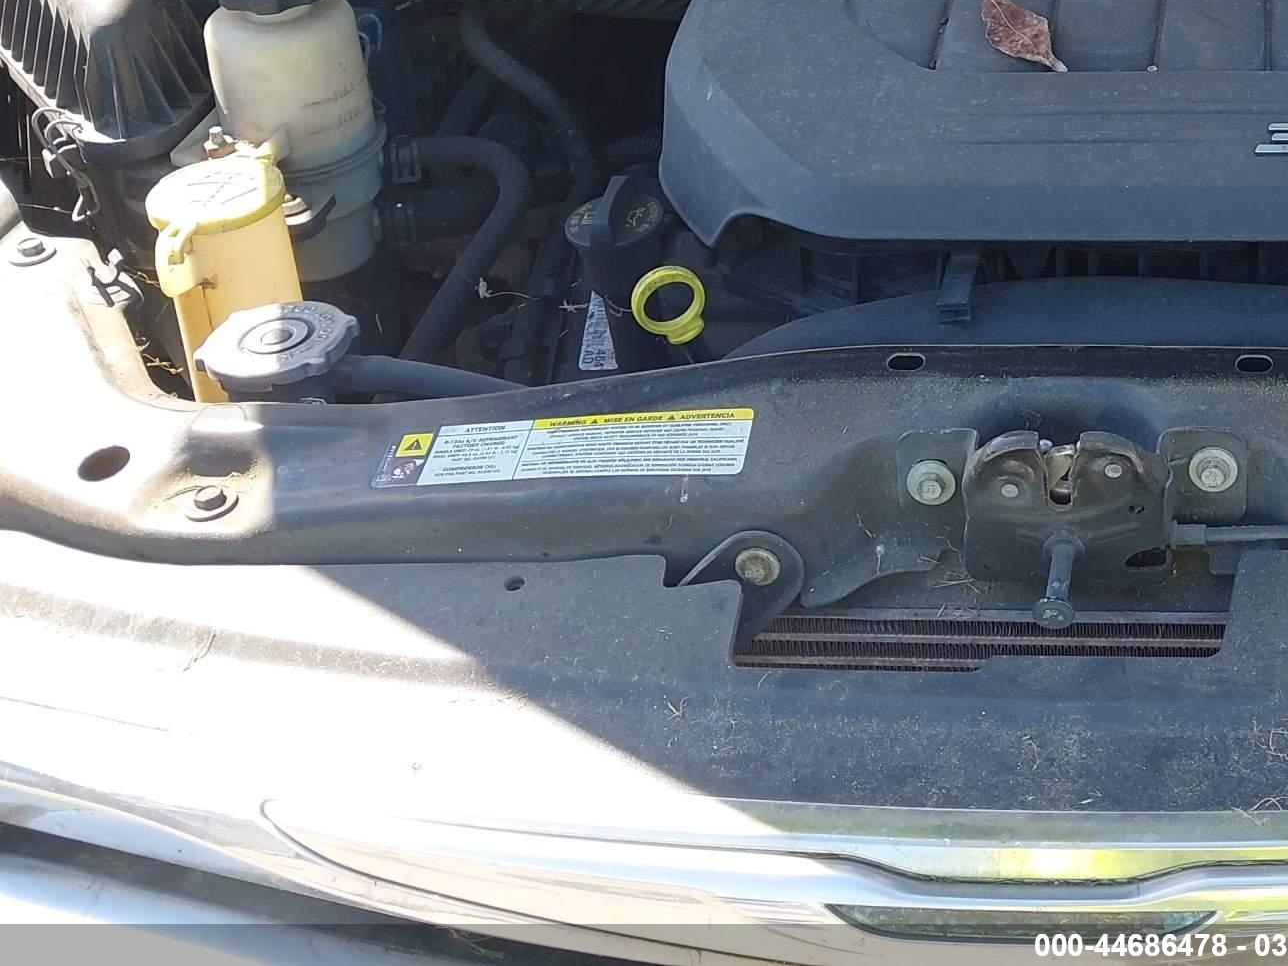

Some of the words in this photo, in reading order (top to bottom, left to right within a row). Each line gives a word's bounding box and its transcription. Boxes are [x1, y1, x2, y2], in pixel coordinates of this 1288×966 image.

[636, 414, 664, 422] GARDE
[679, 412, 735, 420] ADVERTENCIA
[550, 419, 587, 427] WARNING
[465, 425, 507, 434] ATTENTION
